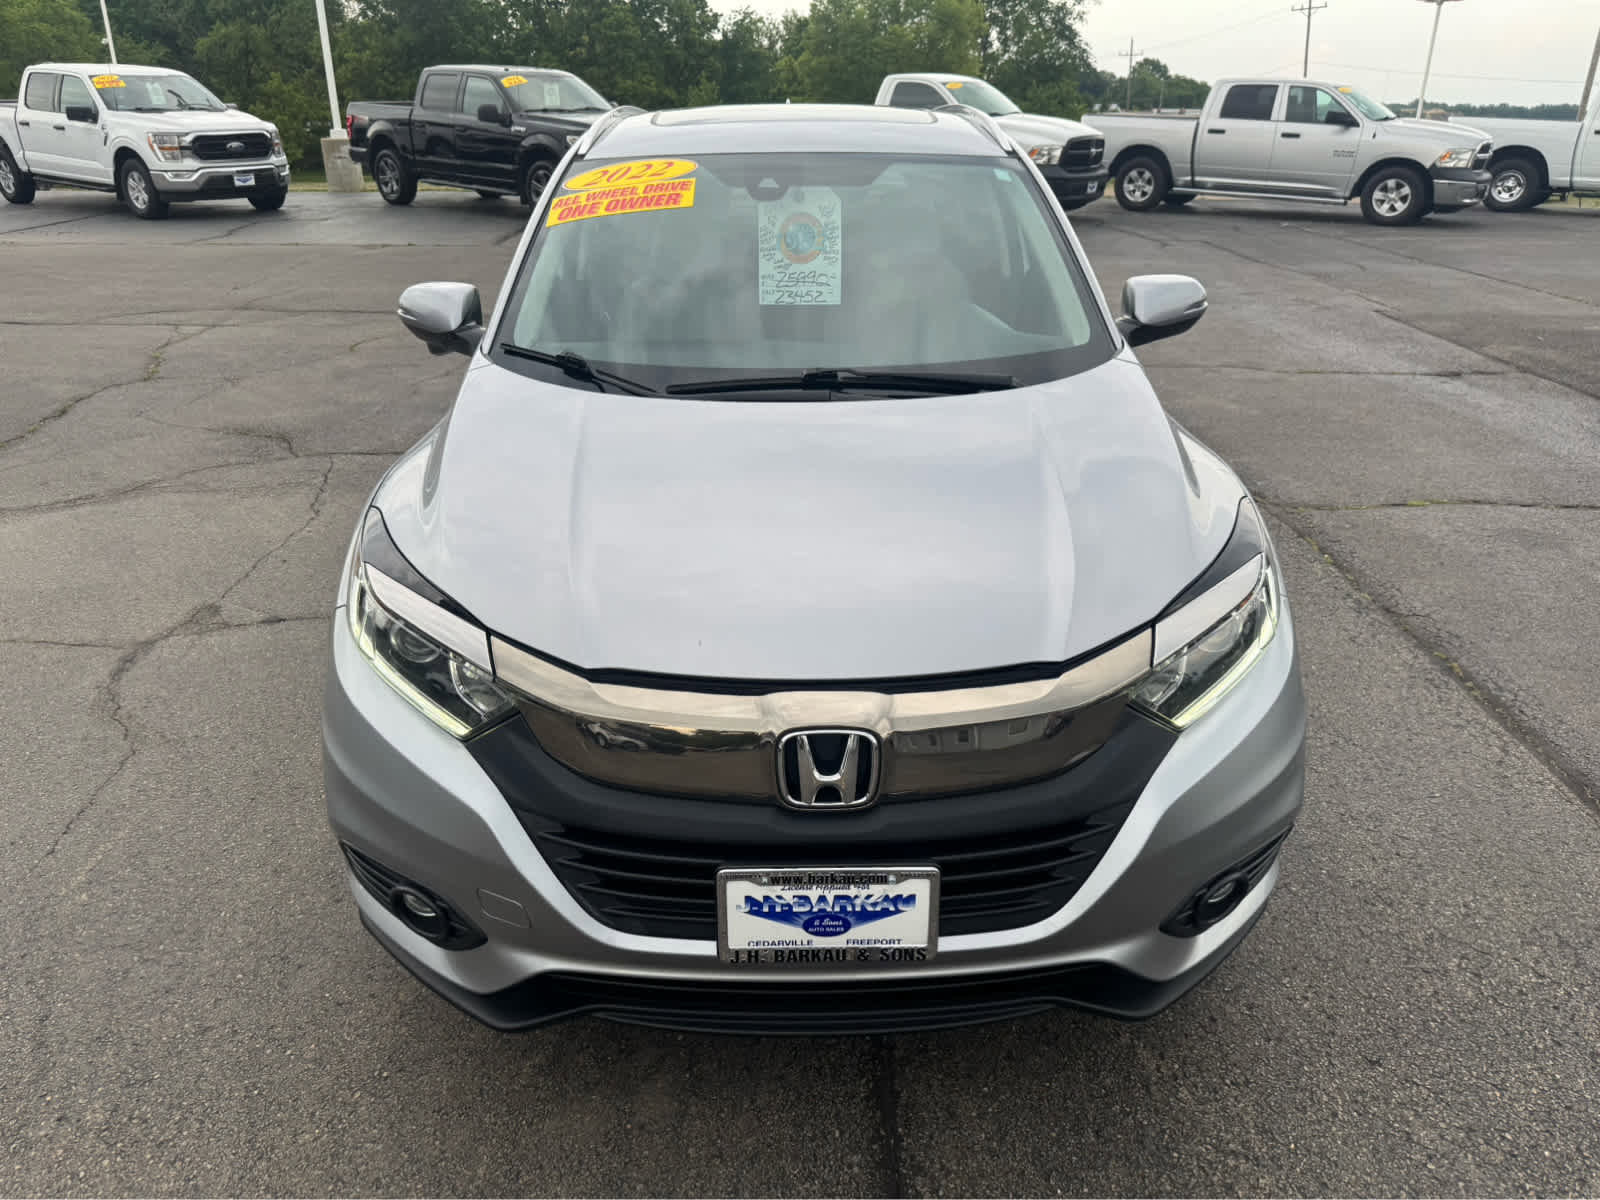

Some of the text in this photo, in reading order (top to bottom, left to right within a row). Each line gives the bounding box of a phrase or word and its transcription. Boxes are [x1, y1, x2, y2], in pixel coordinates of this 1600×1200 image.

[583, 161, 675, 187] 2022
[552, 180, 693, 210] ALL WHEEL DRIVE
[557, 193, 684, 221] ONE OWNER
[770, 872, 888, 885] www.barkau.com
[774, 948, 848, 963] BARKAU
[856, 948, 870, 961] &
[880, 948, 927, 962] SONS
